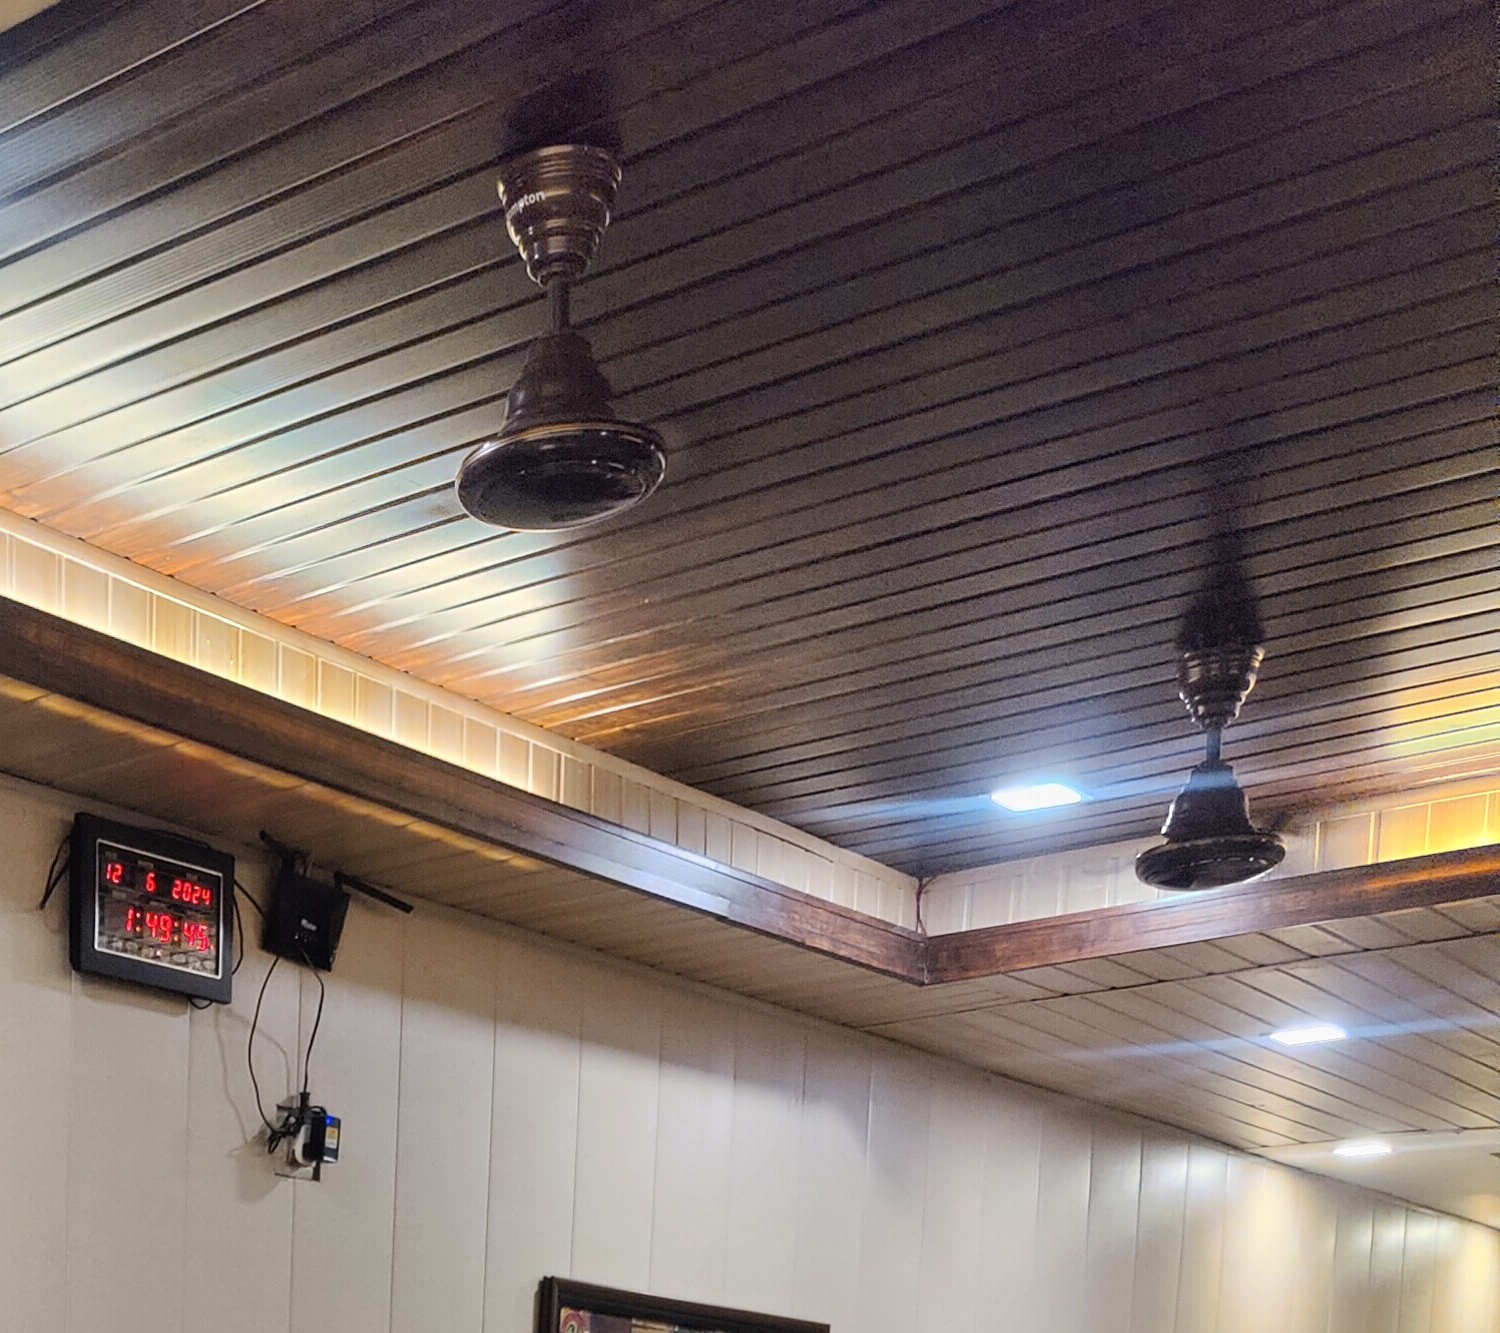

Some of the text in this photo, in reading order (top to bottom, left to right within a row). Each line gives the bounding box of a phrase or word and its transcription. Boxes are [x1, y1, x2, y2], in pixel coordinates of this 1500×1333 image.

[106, 863, 213, 905] 12 6 2024
